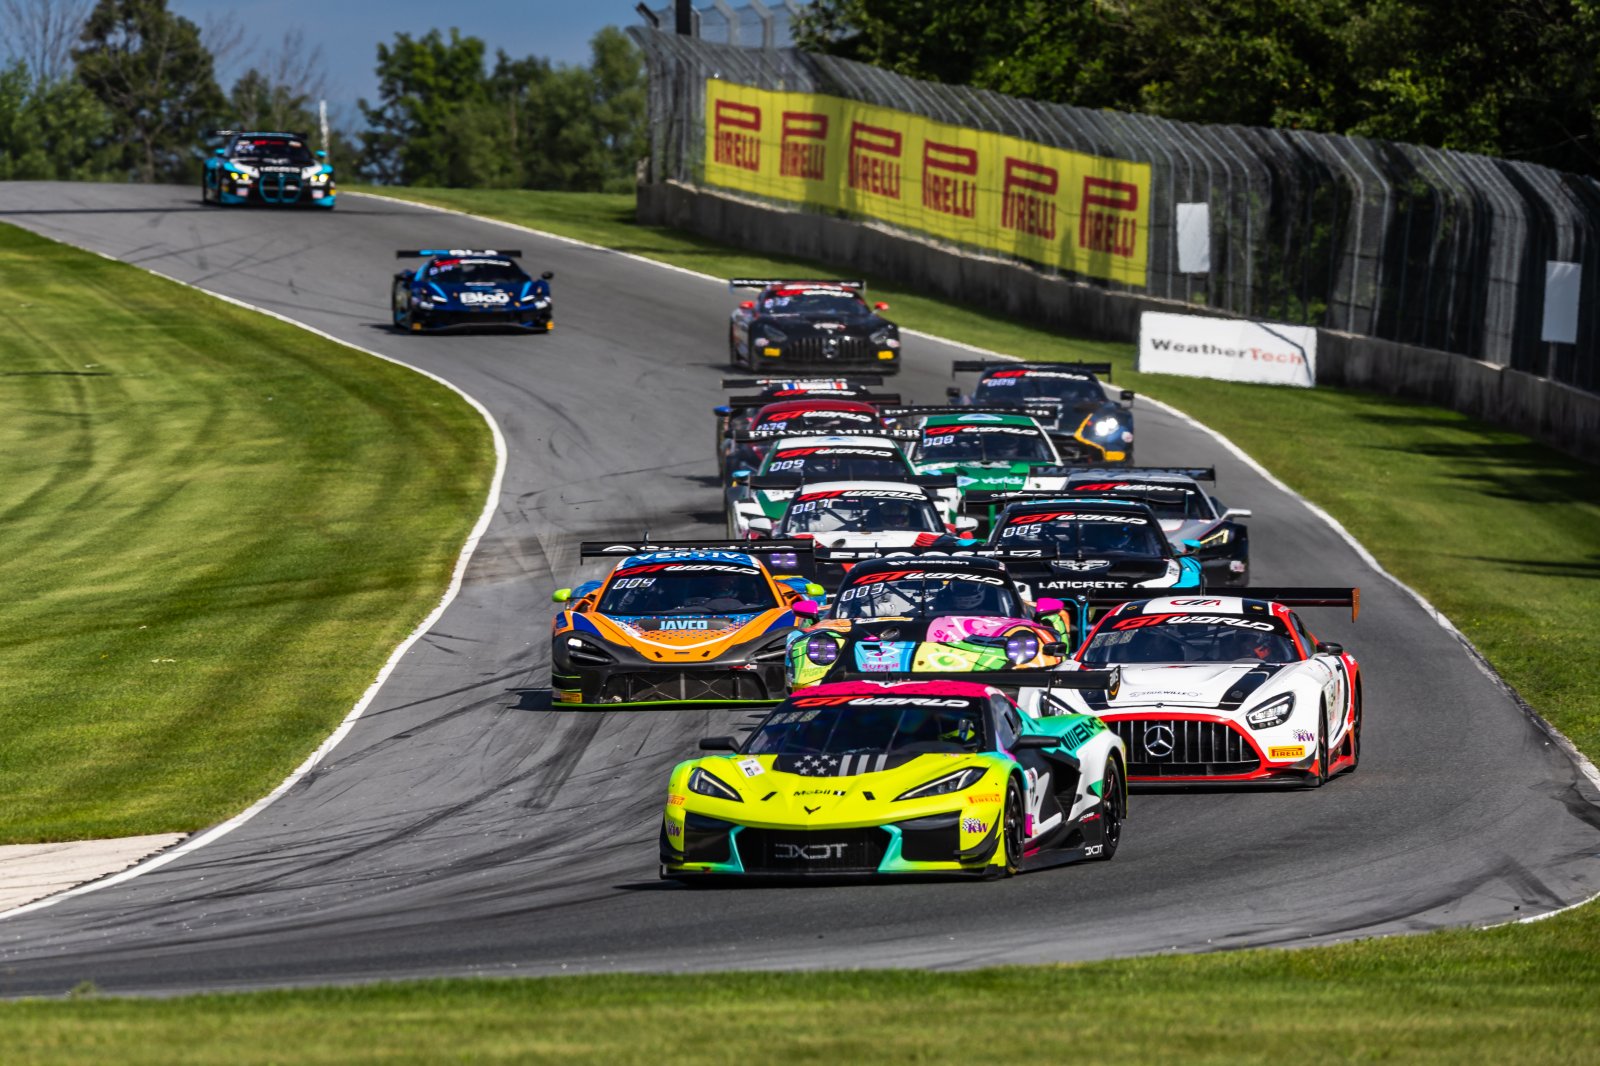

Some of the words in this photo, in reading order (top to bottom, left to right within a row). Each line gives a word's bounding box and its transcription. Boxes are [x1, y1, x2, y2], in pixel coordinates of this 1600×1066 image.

[714, 98, 762, 173] PIRELLI
[780, 111, 829, 181] PIRELLI
[848, 121, 903, 200] PIRELLI
[921, 139, 978, 219] PIRELLI
[1001, 156, 1059, 240] PIRELLI
[1079, 176, 1139, 258] PIRELLI
[1151, 338, 1304, 366] WeatherTech
[841, 490, 928, 501] WORLD
[1055, 514, 1148, 525] WORLD
[664, 565, 761, 576] WORLD
[612, 577, 658, 590] 004
[904, 572, 1005, 587] WORLD
[1038, 580, 1129, 590] LATICRETE
[840, 582, 885, 602] 003
[659, 620, 708, 631] JAVCO
[1165, 615, 1276, 632] WORLD
[848, 697, 970, 708] WORLD
[1297, 733, 1315, 742] KW
[1271, 747, 1303, 758] PIRELLI
[967, 822, 988, 834] KW
